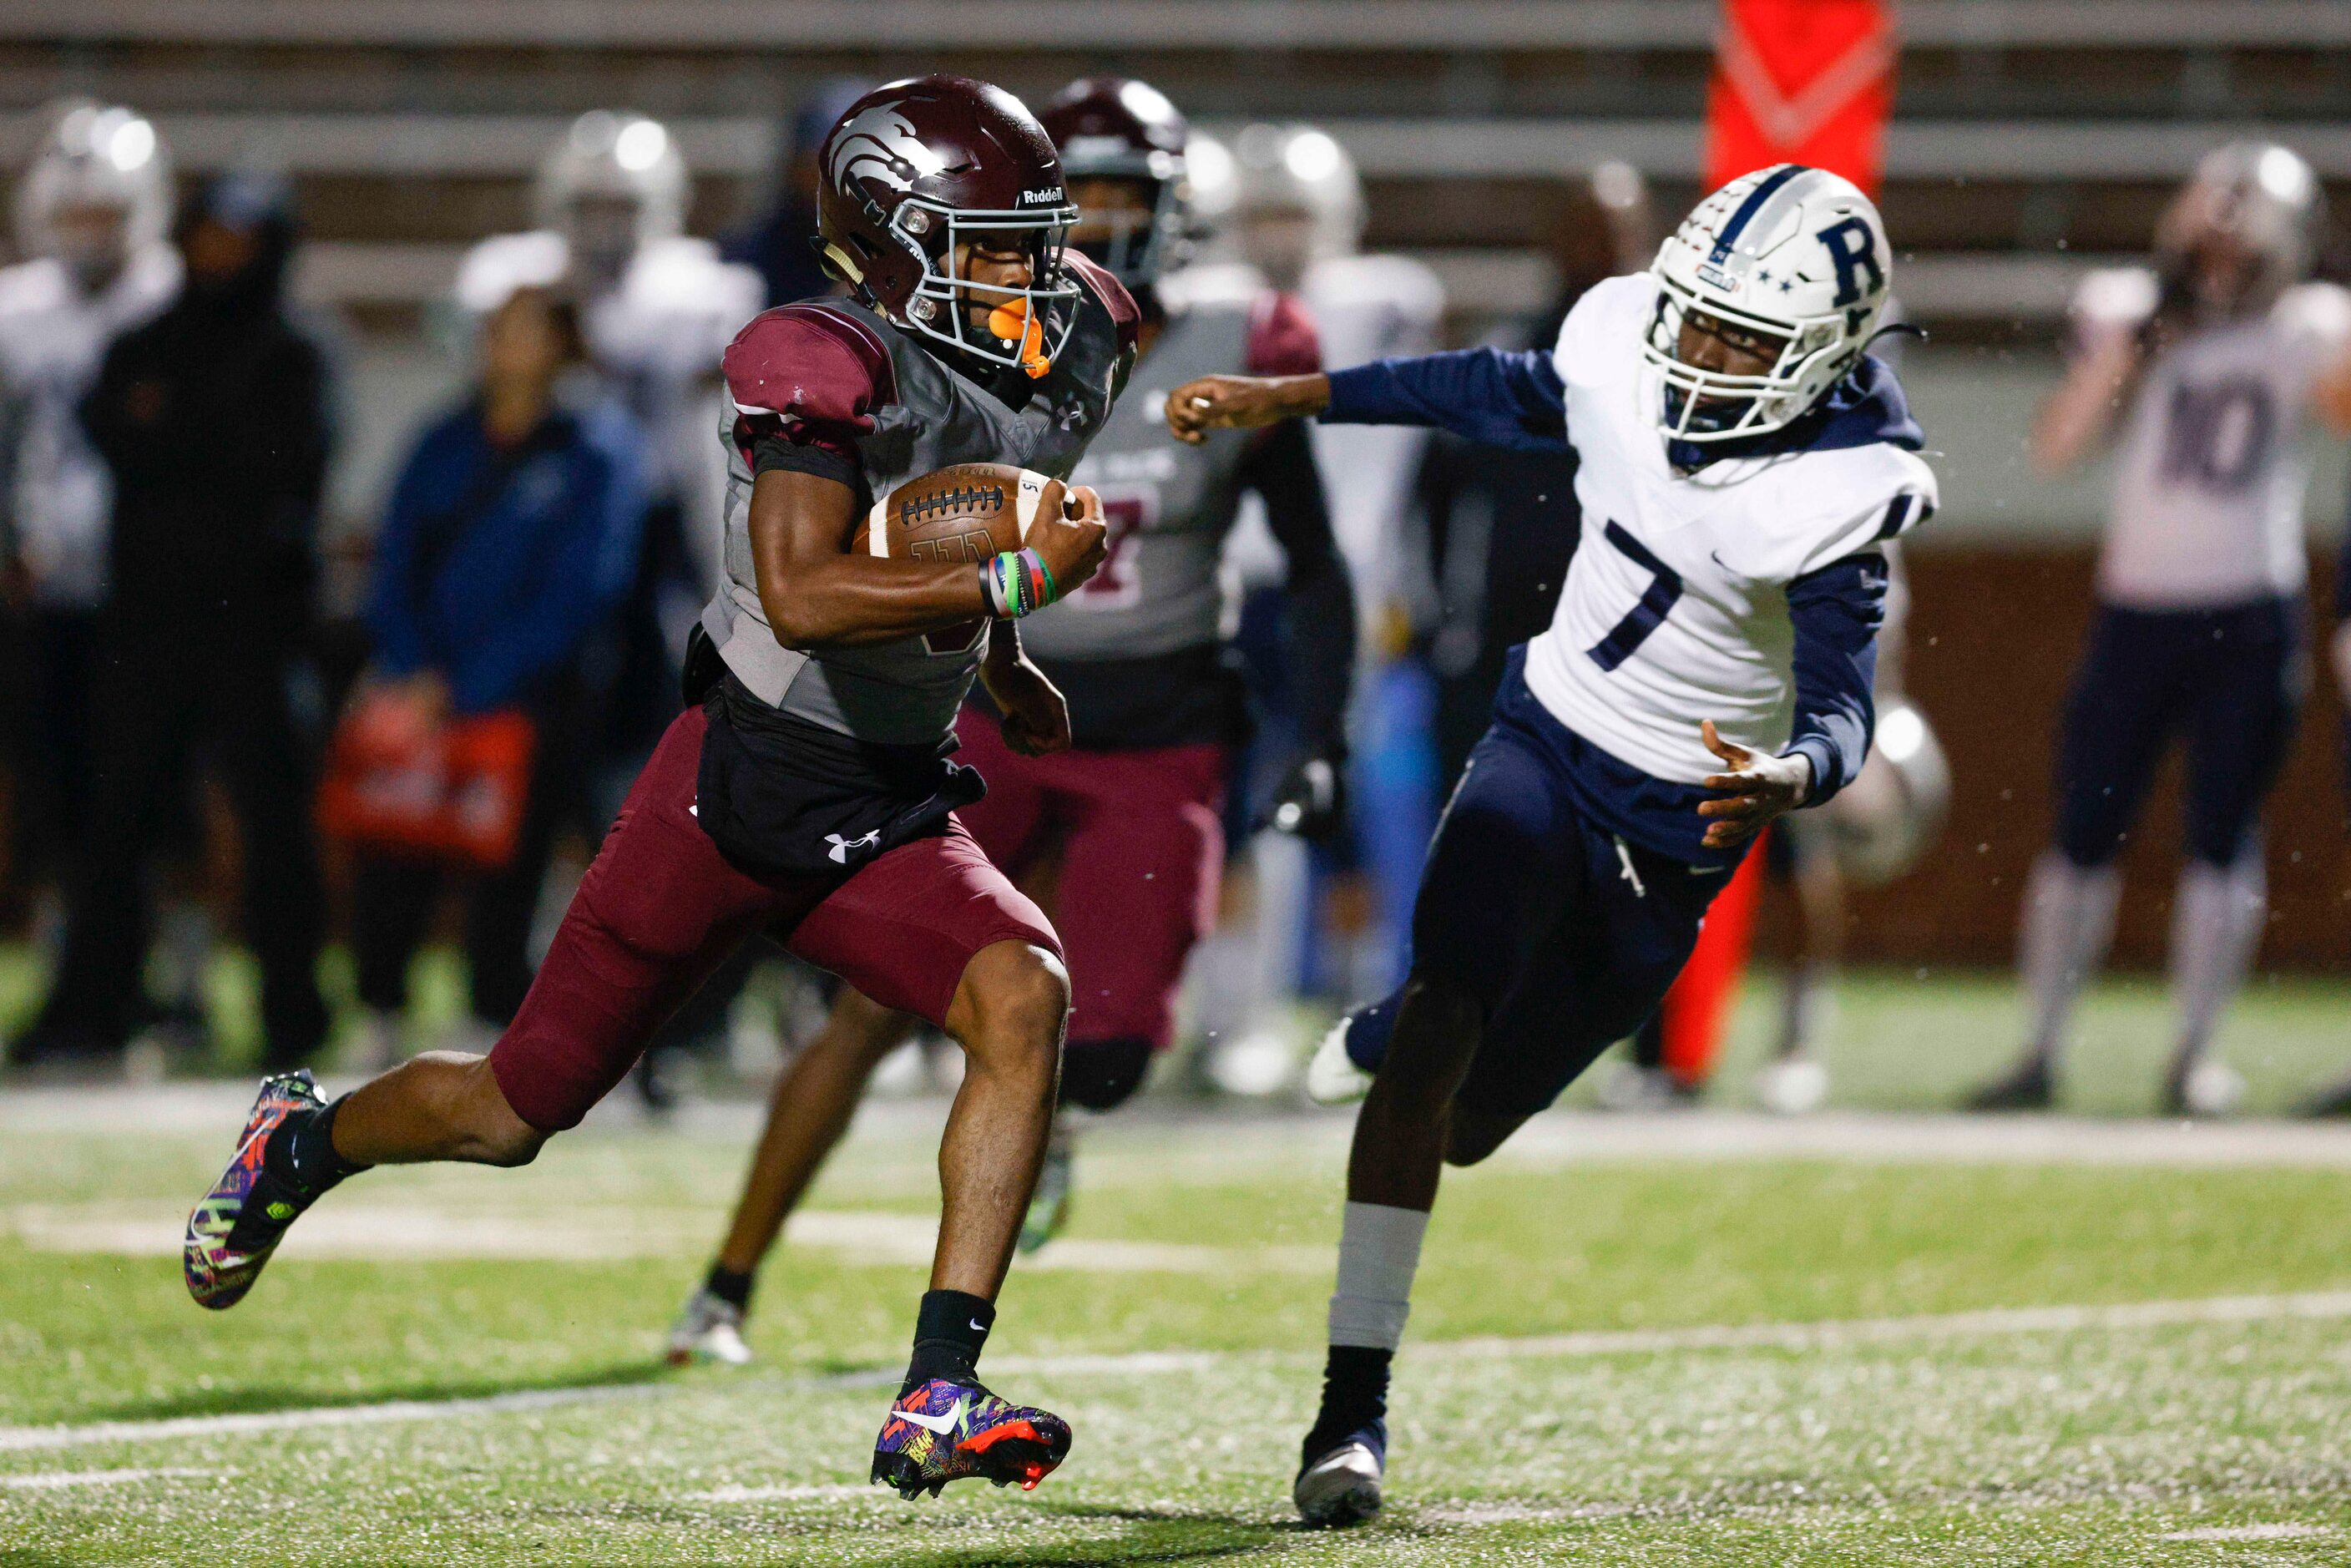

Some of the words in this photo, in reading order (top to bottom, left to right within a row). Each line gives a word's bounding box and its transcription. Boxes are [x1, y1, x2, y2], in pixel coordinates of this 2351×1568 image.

[1023, 186, 1063, 204] Riddell
[1816, 216, 1884, 309] R
[1585, 517, 1684, 673] 7
